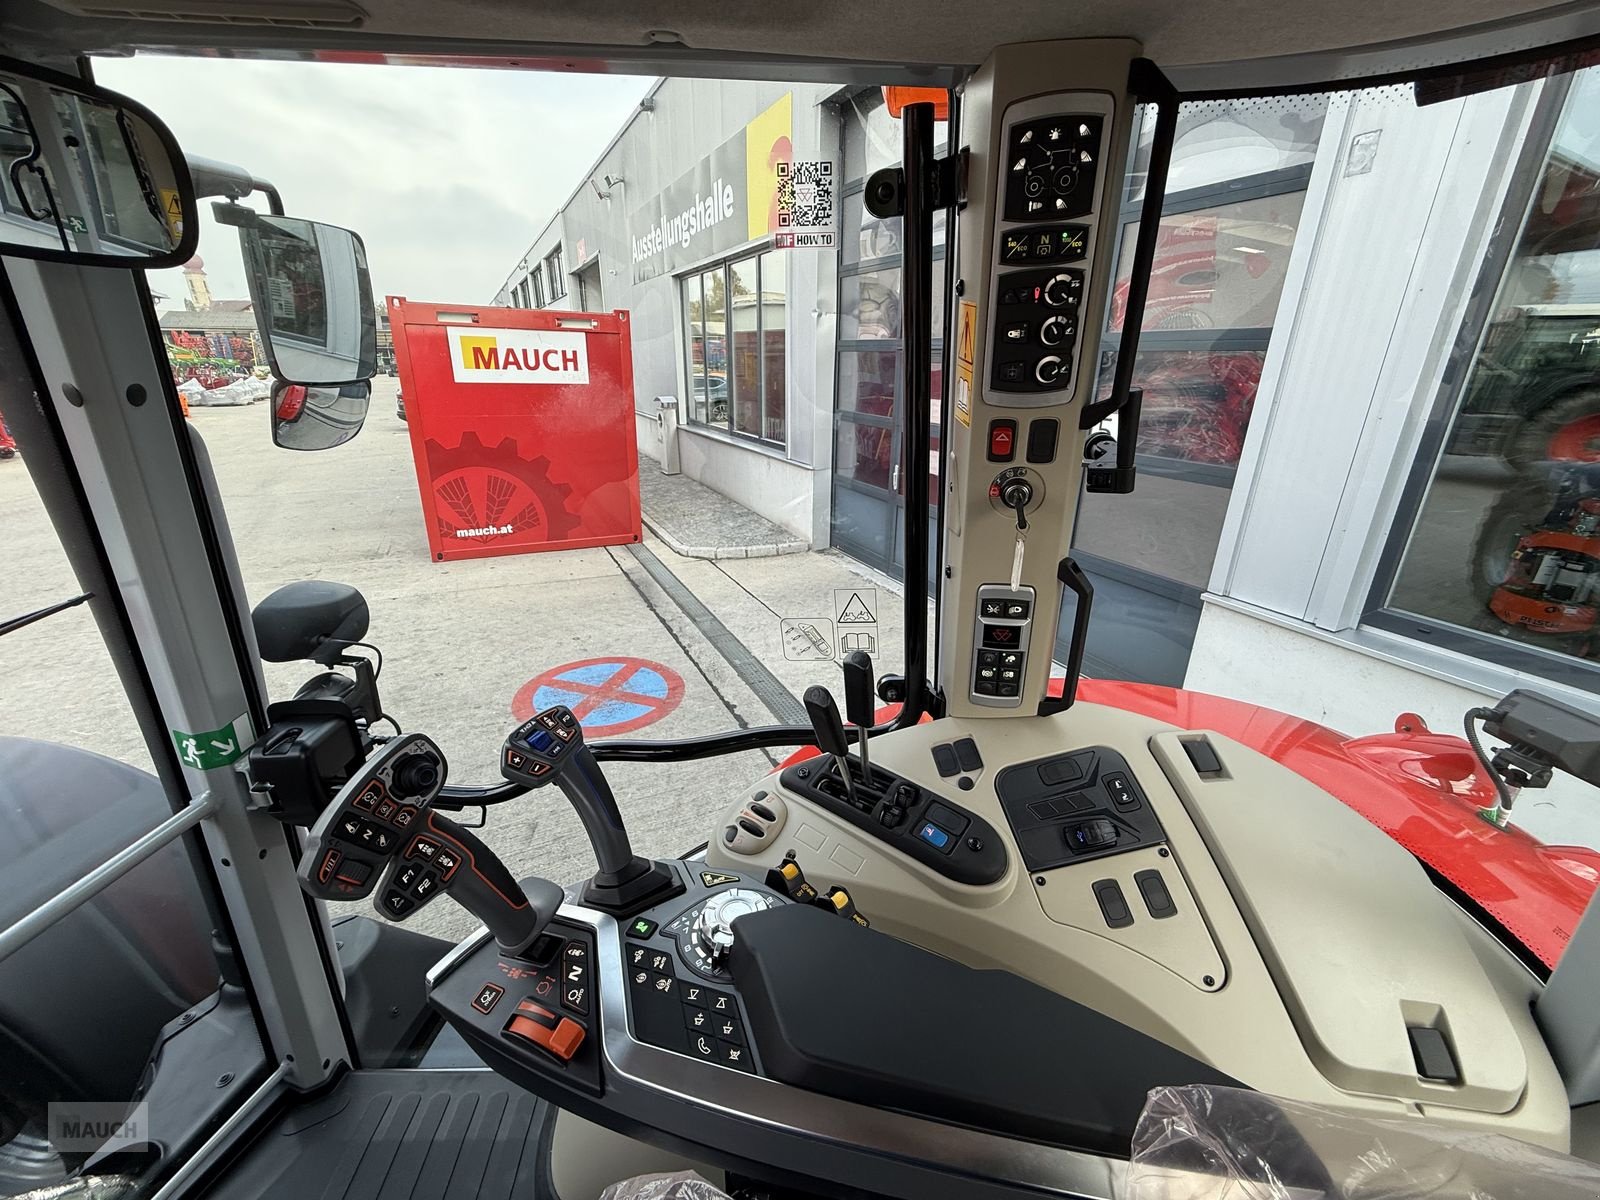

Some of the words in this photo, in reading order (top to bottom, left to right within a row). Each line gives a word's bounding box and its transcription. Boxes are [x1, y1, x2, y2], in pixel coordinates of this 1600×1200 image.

[632, 178, 734, 264] Ausstellungshalle
[776, 234, 794, 247] MF
[796, 235, 819, 245] HOW
[820, 234, 832, 245] TO
[1041, 234, 1050, 244] N
[472, 346, 579, 372] MAUCH
[456, 523, 513, 538] mauch.at
[363, 829, 373, 840] N
[402, 869, 414, 883] F1
[418, 878, 431, 893] F2
[568, 965, 583, 981] N
[575, 988, 585, 1004] AUTO
